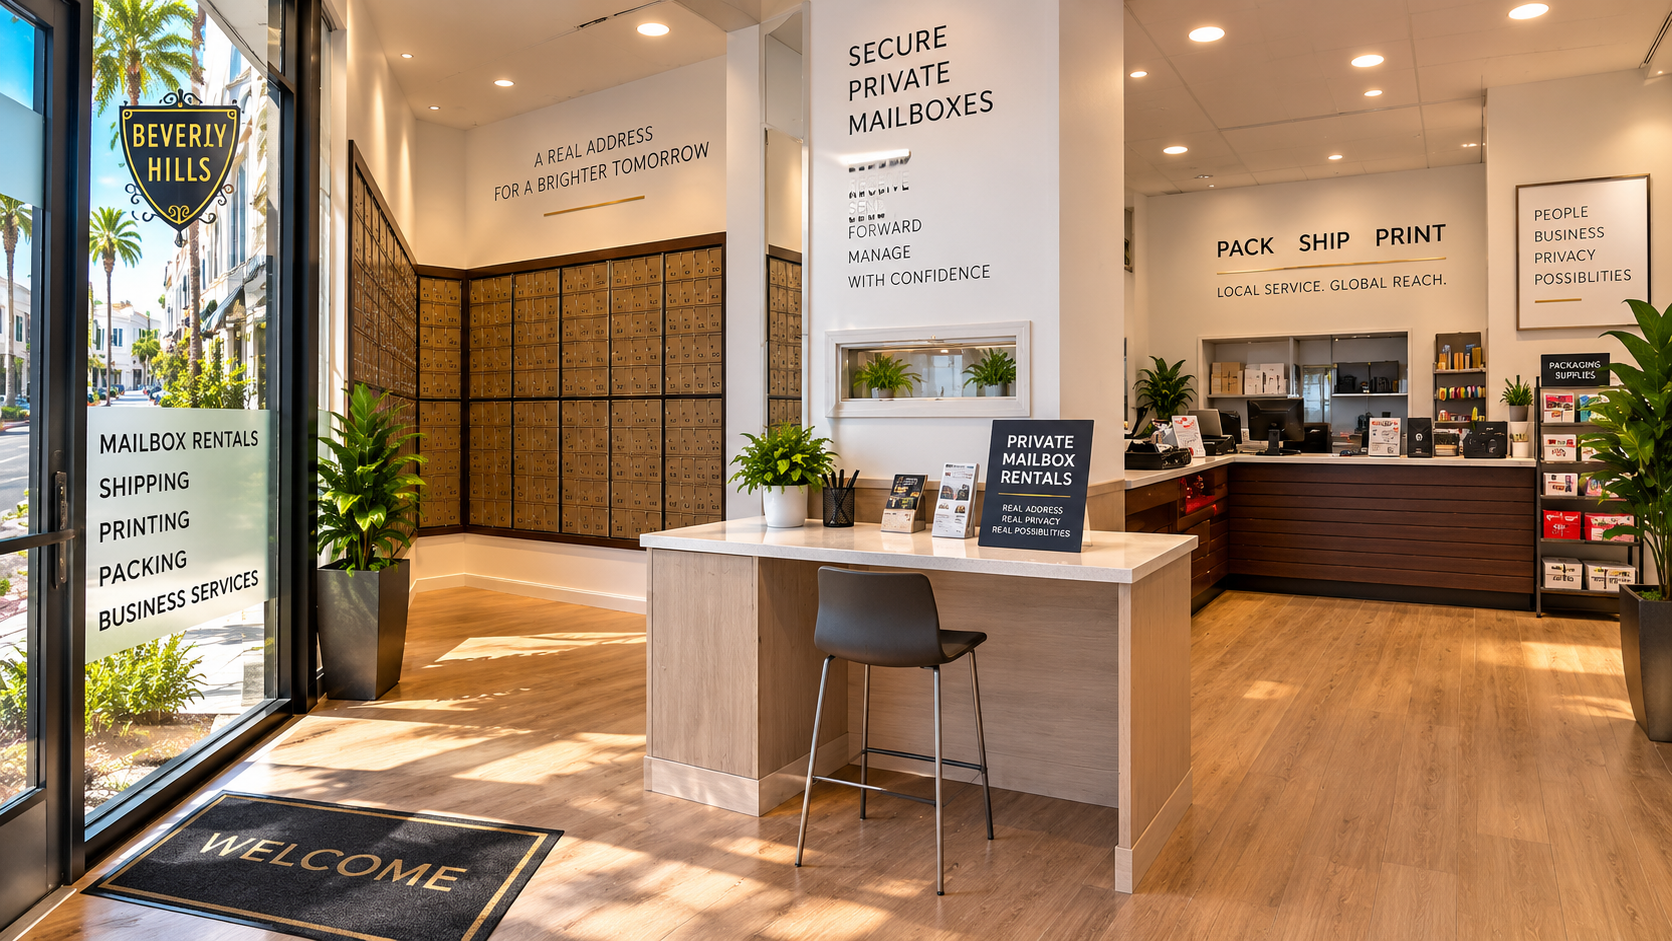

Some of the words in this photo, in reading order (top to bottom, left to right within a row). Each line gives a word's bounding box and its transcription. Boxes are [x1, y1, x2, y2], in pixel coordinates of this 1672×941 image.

[849, 25, 947, 67] SECURE
[849, 61, 950, 101] PRIVATE
[849, 90, 994, 135] MAILBOXES
[132, 123, 227, 148] BEVERLY
[533, 152, 543, 168] A
[547, 143, 582, 165] REAL
[586, 125, 653, 156] ADDRESS
[148, 157, 211, 182] HILLS
[494, 182, 520, 201] FOR
[523, 180, 533, 195] A
[538, 163, 607, 193] BRIGHTER
[612, 141, 709, 176] TOMORROW
[1534, 205, 1588, 221] PEOPLE
[848, 219, 922, 239] FORWARD
[1217, 236, 1274, 258] PACK
[1299, 231, 1350, 252] SHIP
[1376, 223, 1446, 247] PRINT
[1534, 226, 1605, 243] BUSINESS
[848, 245, 911, 264] MANAGE
[1534, 249, 1596, 264] PRIVACY
[848, 273, 885, 288] WITH
[890, 264, 991, 286] CONFIDENCE
[1217, 285, 1260, 298] LOCAL
[1264, 280, 1325, 295] SERVICE.
[1329, 276, 1387, 291] GLOBAL
[1392, 273, 1447, 288] REACH.
[1534, 269, 1632, 286] POSSIBLITIES
[1549, 361, 1601, 369] PACKAGING
[100, 432, 186, 454] MAILBOX
[192, 430, 259, 449] RENTALS
[1007, 435, 1074, 449] PRIVATE
[1002, 453, 1076, 467] MAILBOX
[99, 471, 189, 498] SHIPPING
[1000, 470, 1072, 486] RENTALS
[1001, 515, 1023, 524] REAL
[1025, 516, 1061, 525] PRIVACY
[1002, 504, 1023, 513] REAL
[99, 510, 190, 543] PRINTING
[992, 525, 1013, 534] REAL
[99, 550, 187, 587] PACKING
[99, 590, 186, 632] BUSINESS
[191, 569, 259, 604] SERVICES
[200, 832, 467, 892] WELCOME
